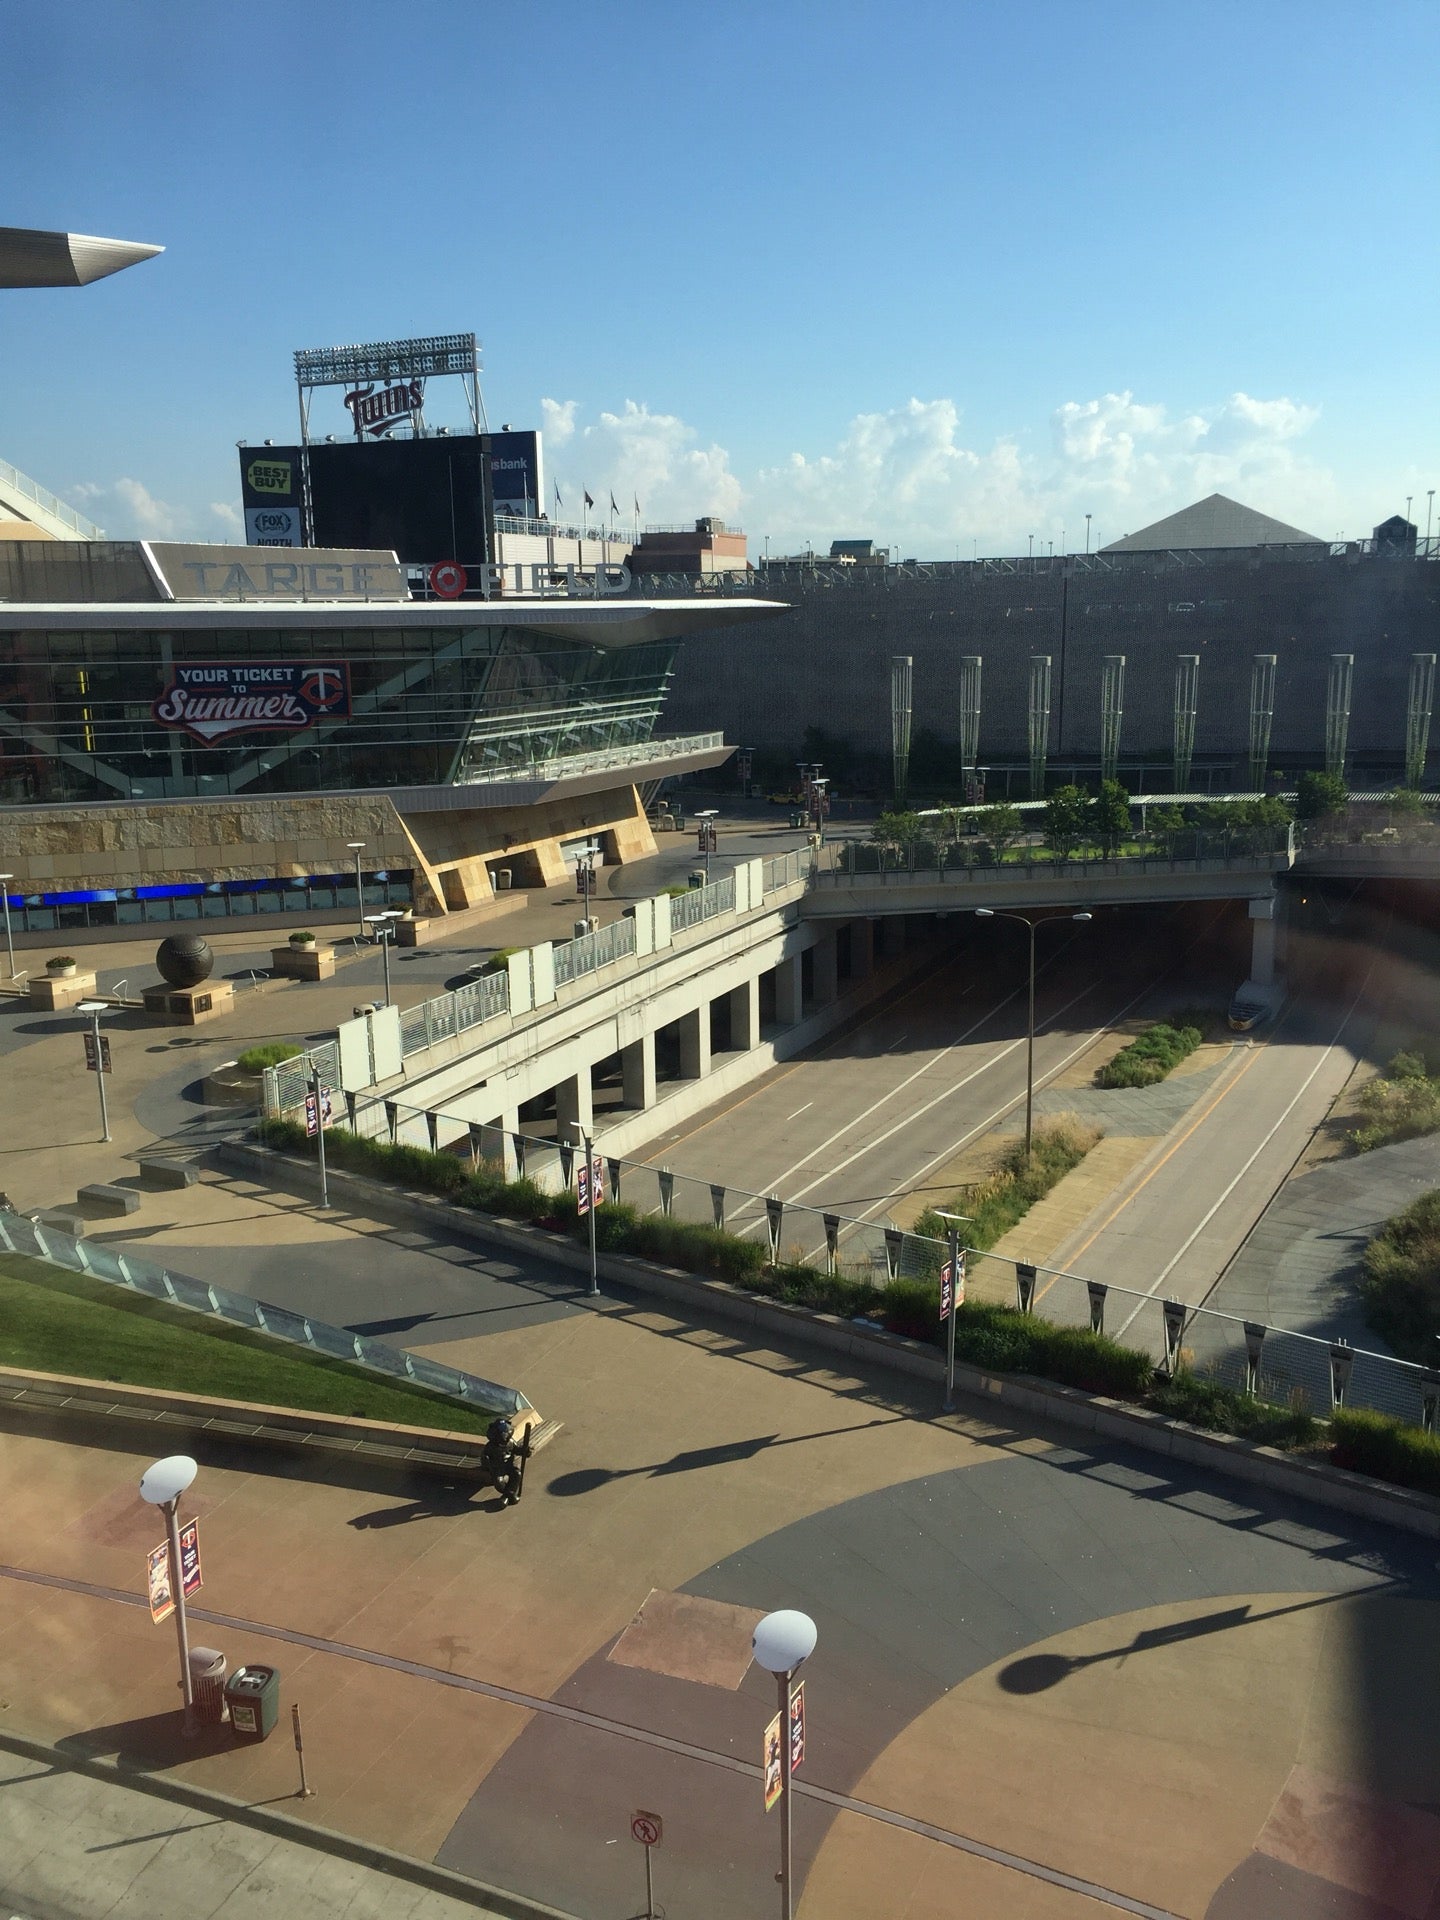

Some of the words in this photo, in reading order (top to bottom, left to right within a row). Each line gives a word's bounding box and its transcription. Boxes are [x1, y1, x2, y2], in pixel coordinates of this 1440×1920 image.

[344, 380, 424, 436] Twins
[253, 466, 290, 478] BEST
[254, 477, 287, 489] BUY
[262, 514, 283, 527] FOX
[183, 562, 421, 594] TARGET
[480, 563, 632, 594] FIELD
[180, 669, 229, 683] YOUR
[232, 668, 294, 681] TICKET
[231, 685, 246, 693] TO
[158, 689, 307, 724] Summer
